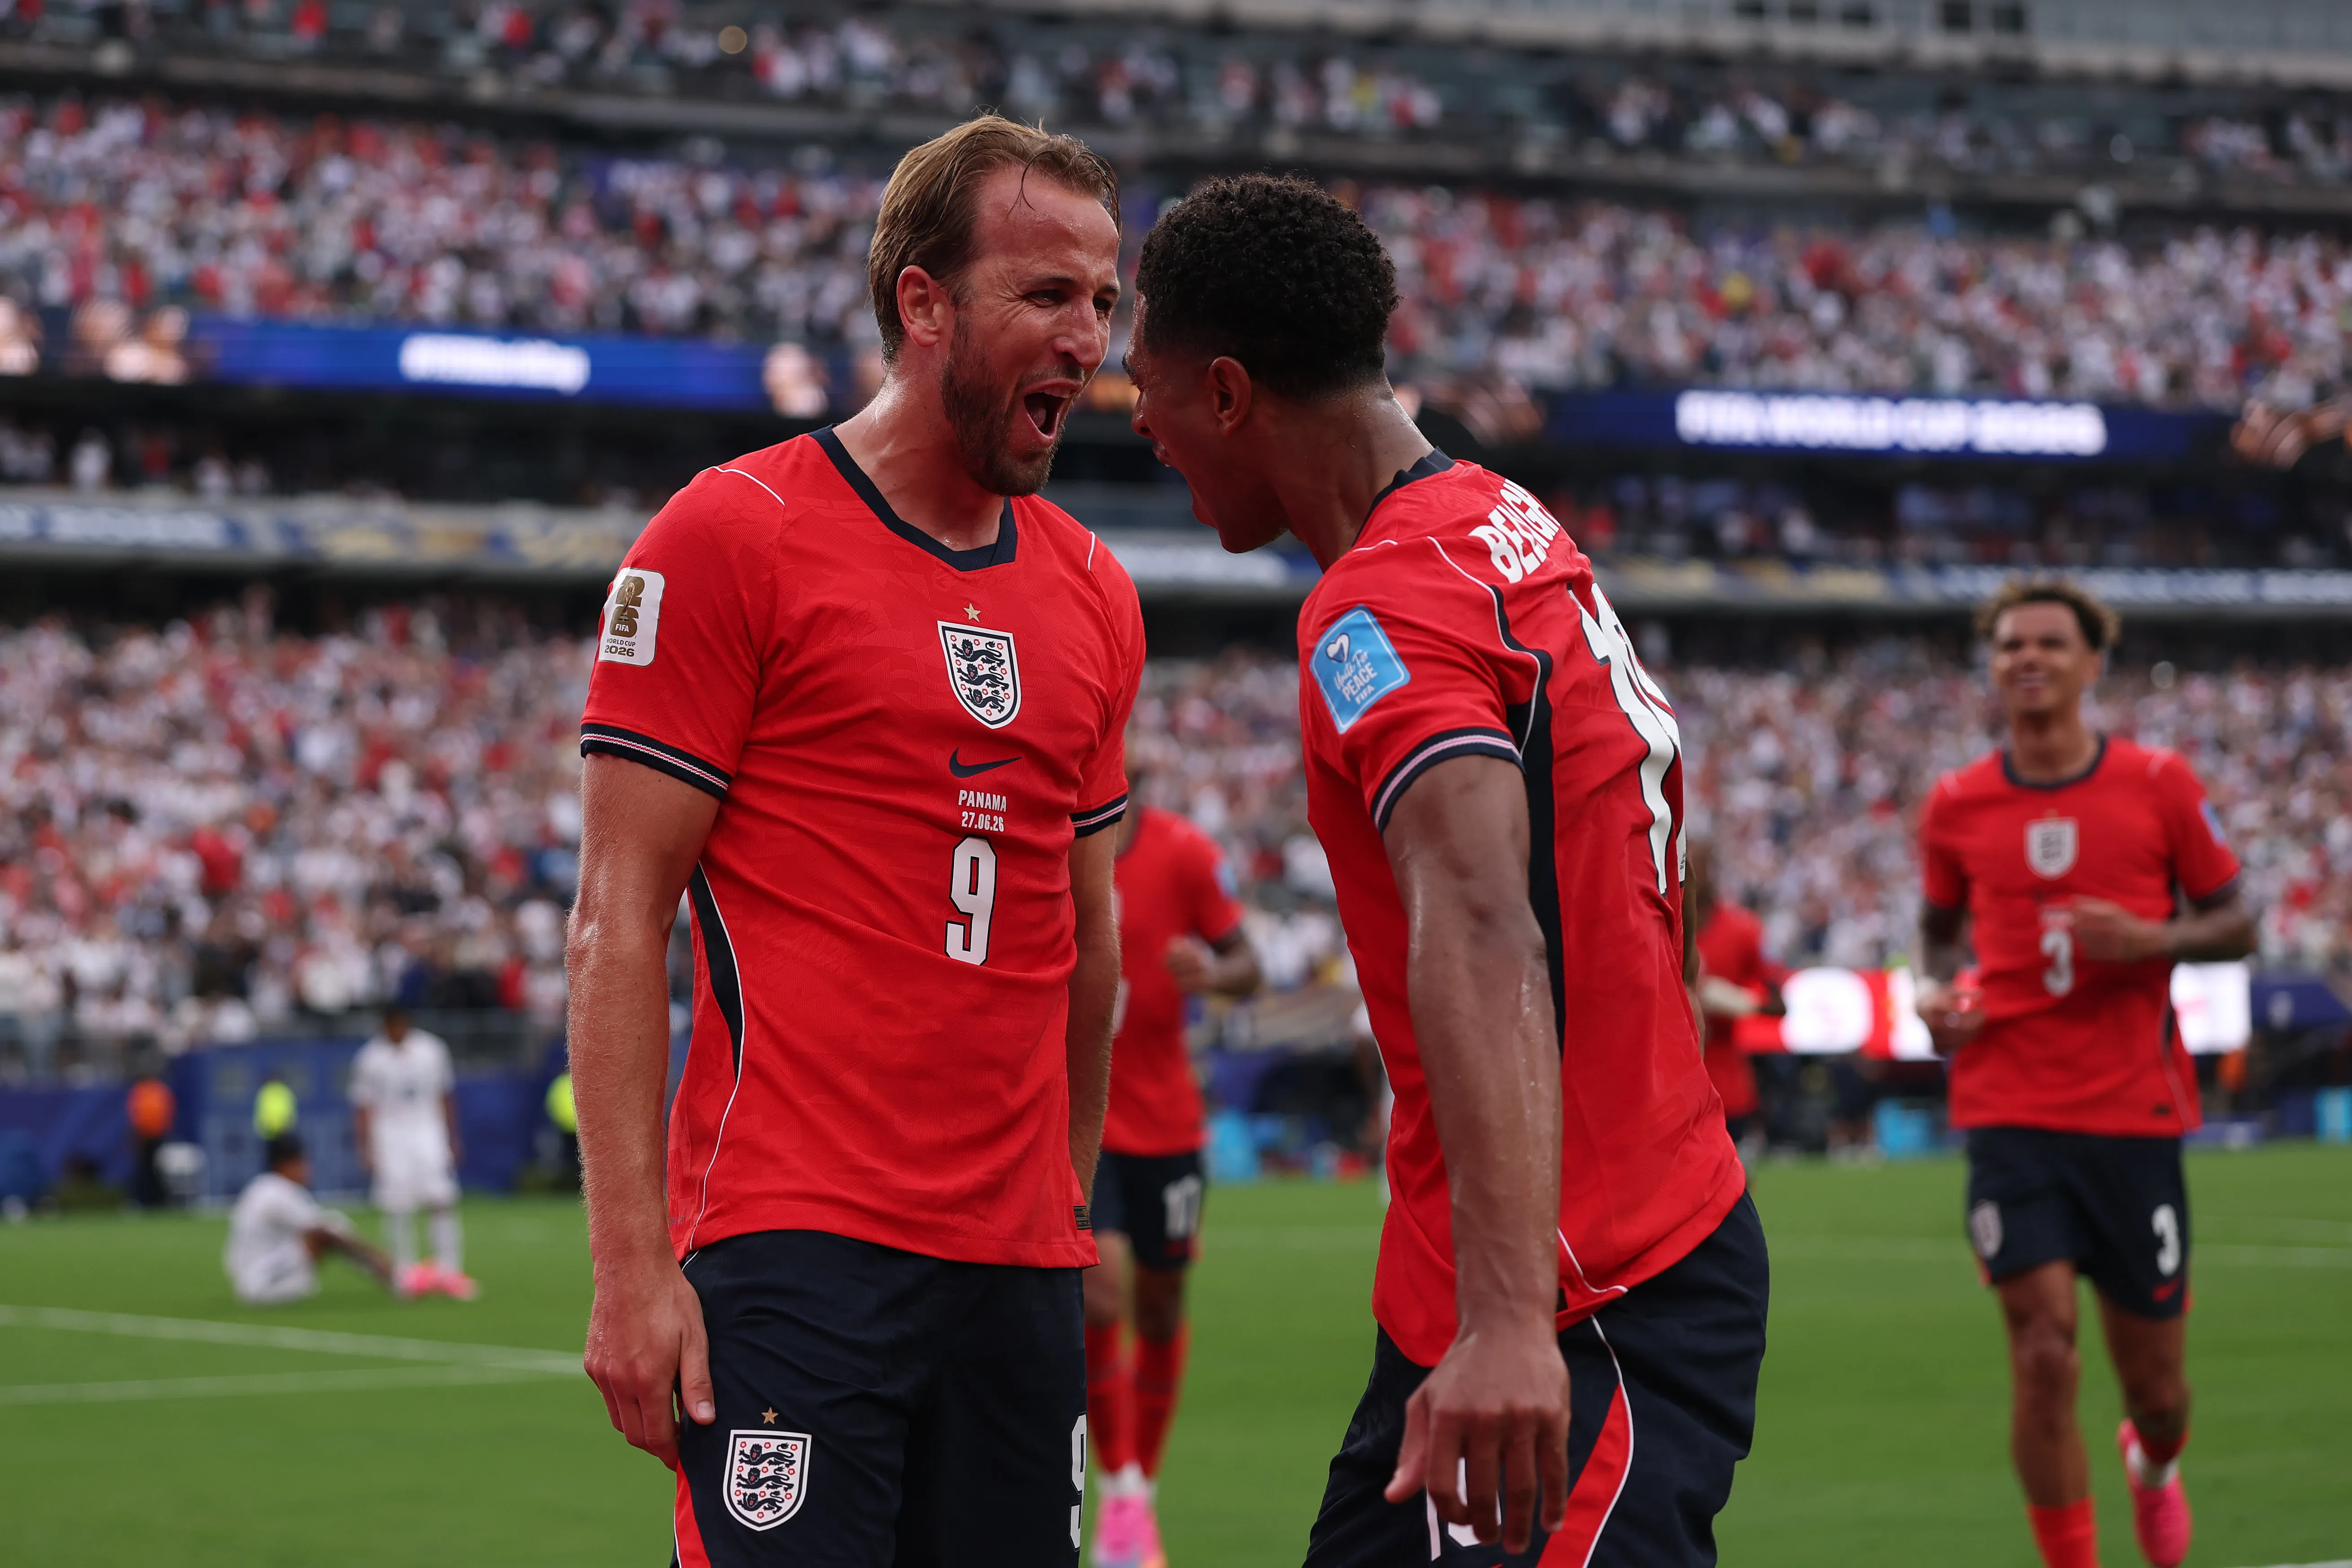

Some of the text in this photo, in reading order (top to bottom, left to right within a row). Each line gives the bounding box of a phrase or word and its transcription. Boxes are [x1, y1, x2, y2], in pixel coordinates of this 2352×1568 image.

[615, 624, 629, 632] FIFA
[604, 645, 635, 657] 2026
[1342, 662, 1377, 702] PEACE
[1355, 685, 1375, 704] FIFA
[958, 790, 1007, 812] PANAMA
[961, 811, 1004, 832] 27.06.26
[946, 836, 997, 966] 9
[2040, 927, 2074, 997] 3
[2150, 1203, 2182, 1277] 3
[1070, 1412, 1087, 1552] 9
